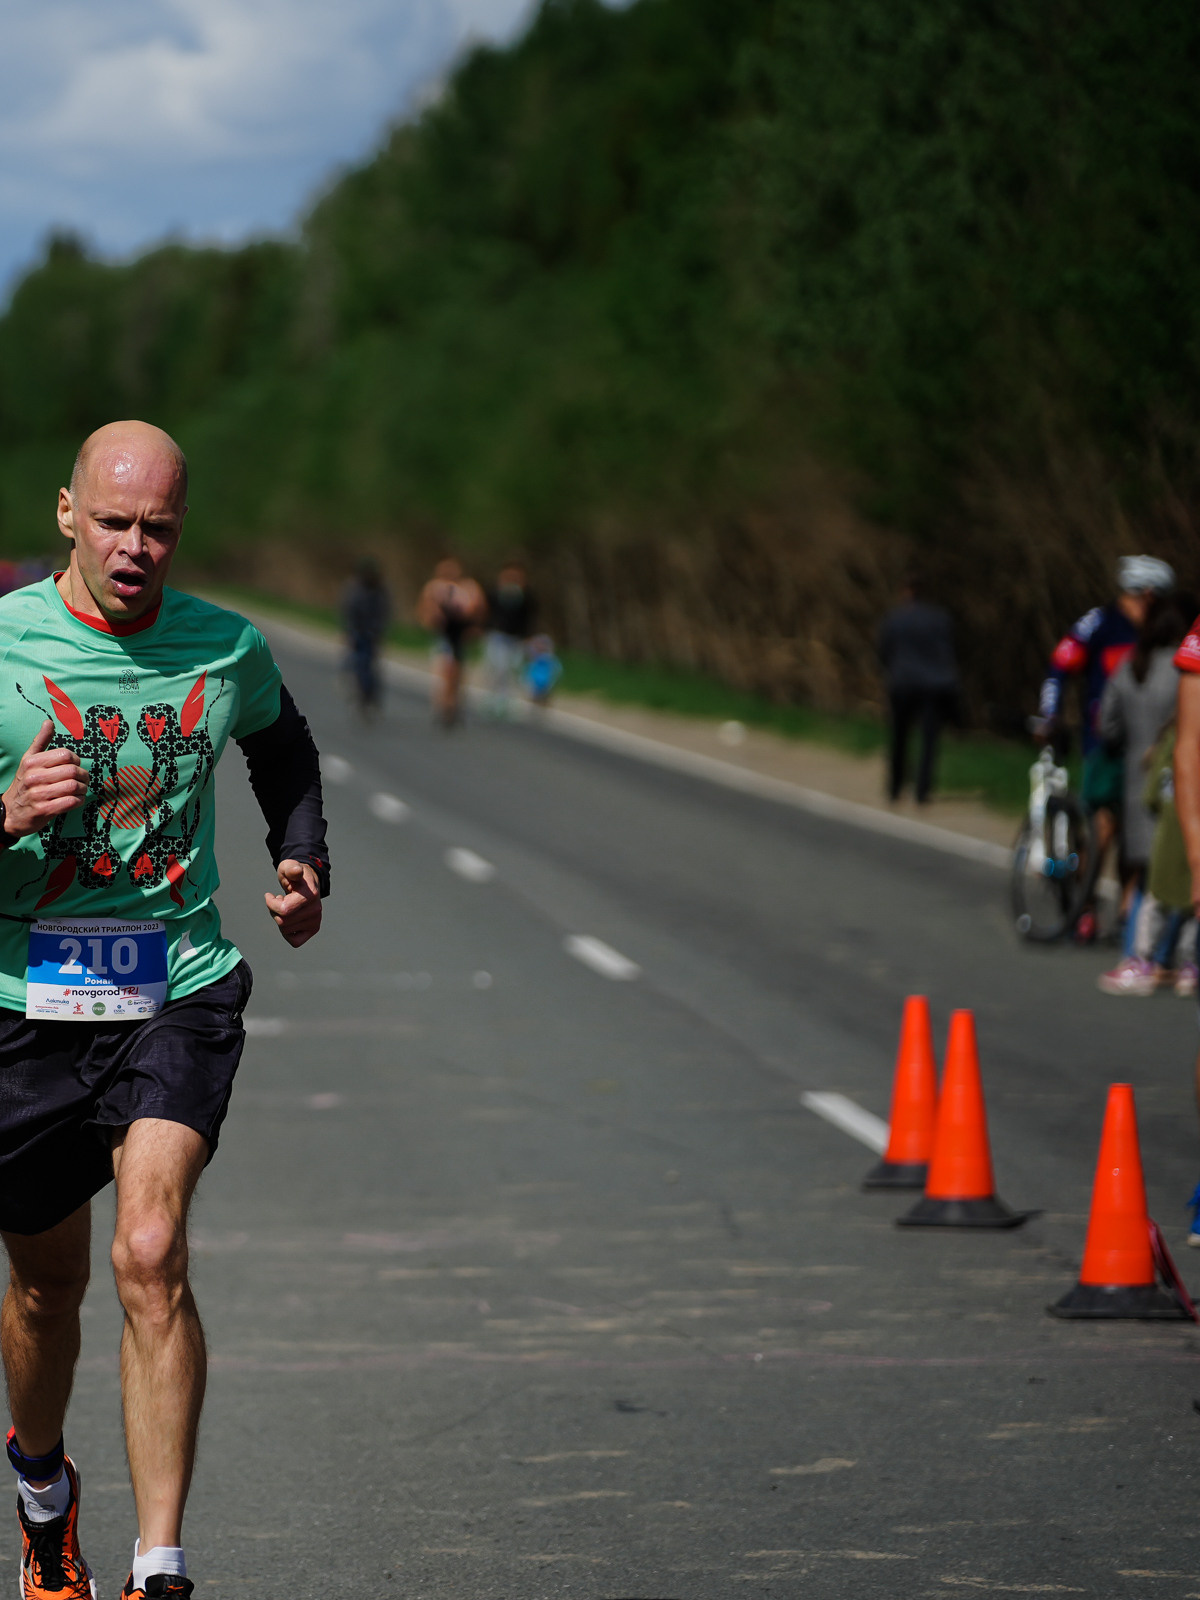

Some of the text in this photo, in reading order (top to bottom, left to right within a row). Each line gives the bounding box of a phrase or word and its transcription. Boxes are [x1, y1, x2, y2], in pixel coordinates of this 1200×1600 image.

[37, 923, 100, 934] НОВГОРОДСКИЙ
[101, 925, 142, 933] ТРИАТЛОН
[58, 937, 139, 975] 210
[84, 976, 114, 985] Роман
